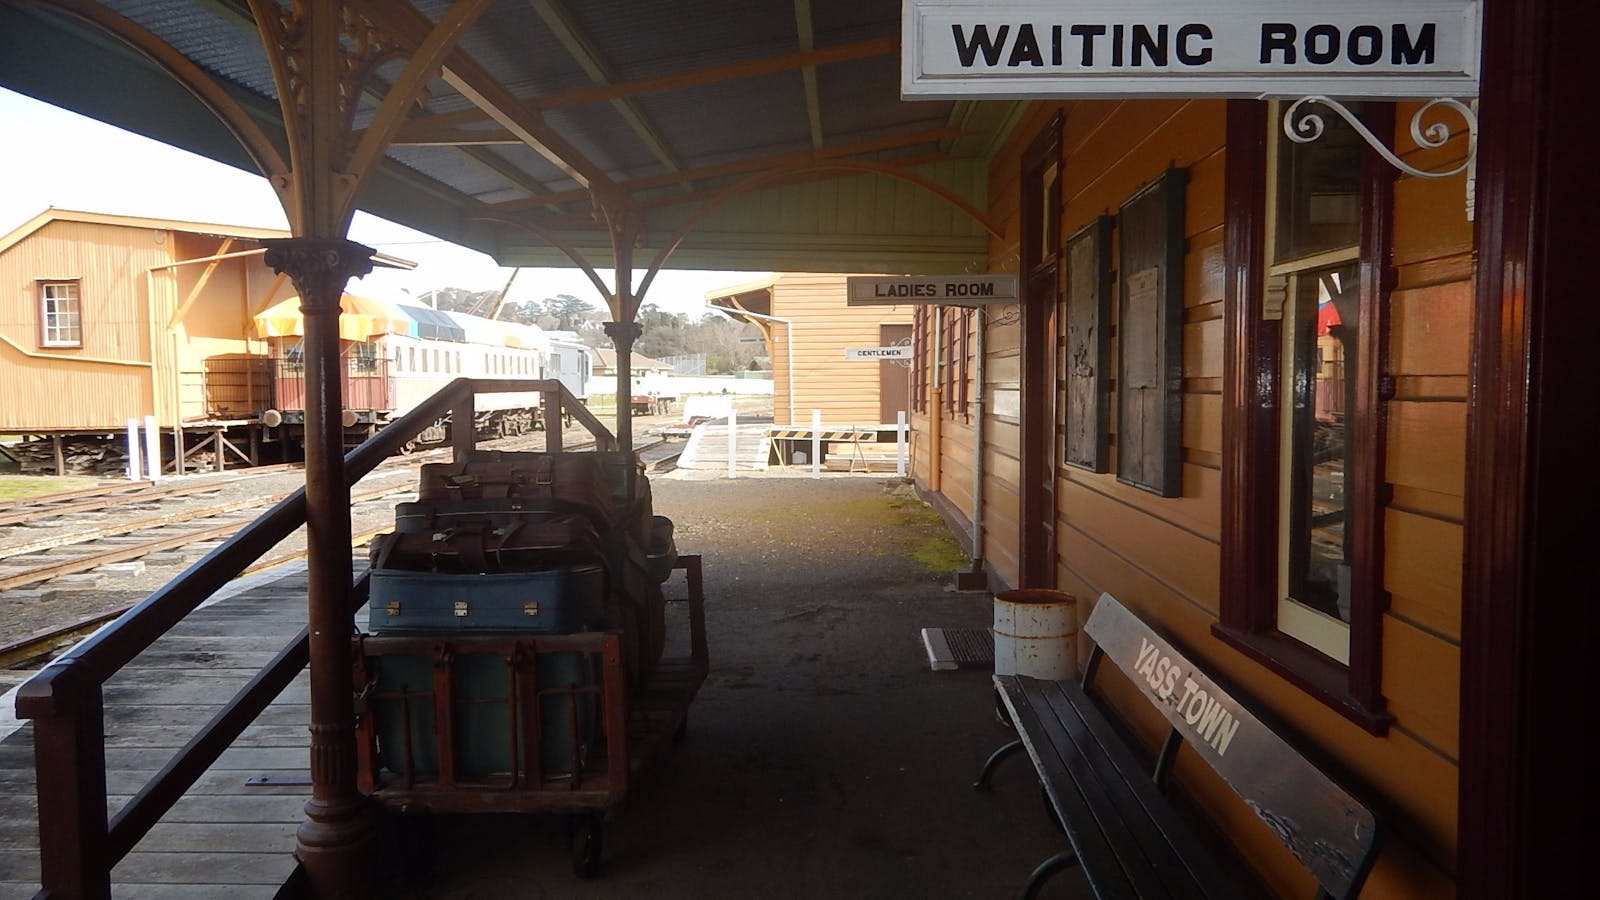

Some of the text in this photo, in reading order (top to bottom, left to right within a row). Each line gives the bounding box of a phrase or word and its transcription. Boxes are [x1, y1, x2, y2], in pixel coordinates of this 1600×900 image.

[952, 23, 1436, 67] WAITING ROOM
[875, 283, 994, 297] LADIES ROOM
[857, 349, 902, 357] GENTLEMEN
[1133, 638, 1240, 757] YASS TOWN
